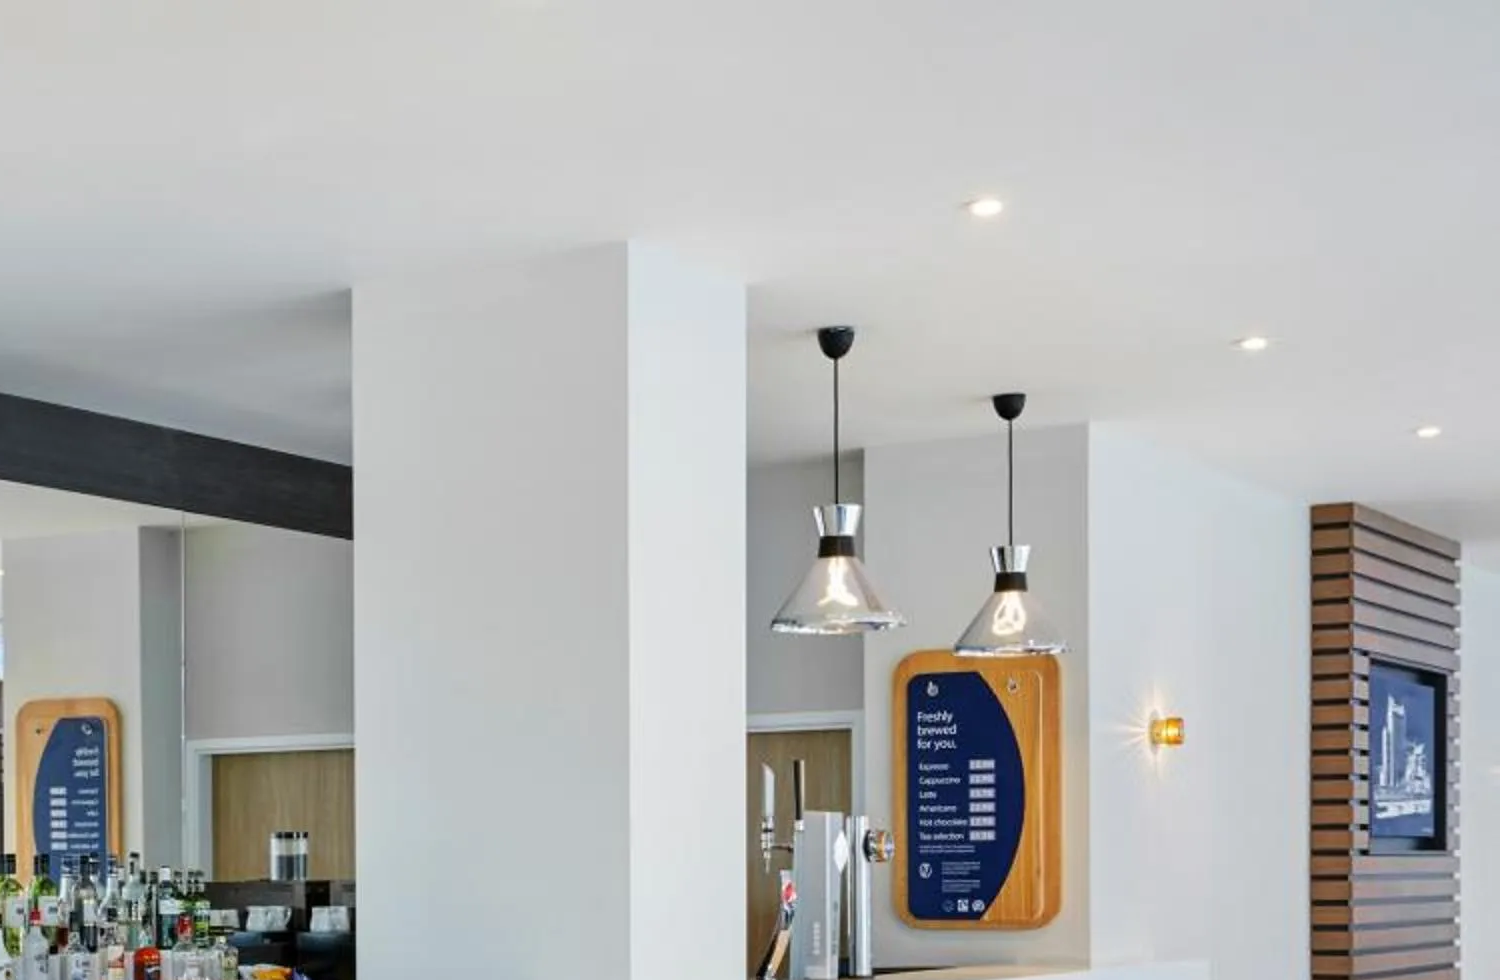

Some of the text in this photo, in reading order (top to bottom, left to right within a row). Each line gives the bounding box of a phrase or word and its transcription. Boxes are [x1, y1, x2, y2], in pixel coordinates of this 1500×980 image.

[917, 710, 953, 723] Freshly
[917, 724, 957, 736] brewed
[917, 738, 957, 752] for you.
